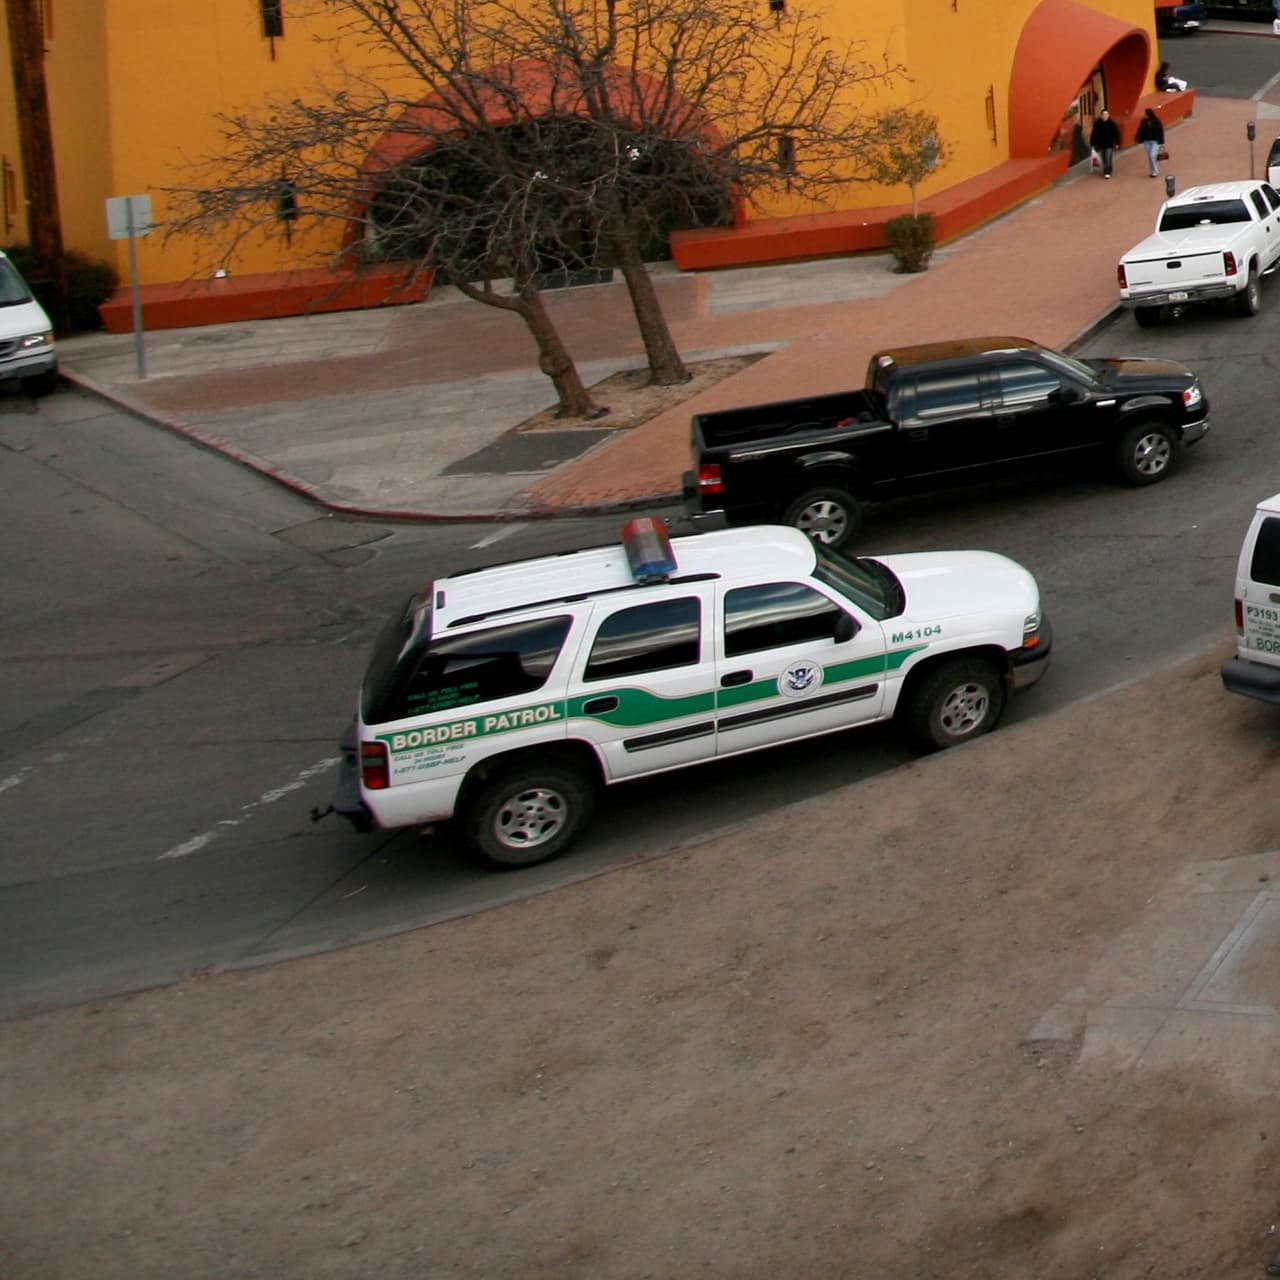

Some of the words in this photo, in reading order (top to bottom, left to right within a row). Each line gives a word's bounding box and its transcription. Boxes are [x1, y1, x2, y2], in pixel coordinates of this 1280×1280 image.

[1247, 606, 1279, 621] P3193
[892, 625, 942, 644] M4104
[392, 721, 477, 750] BORDER
[483, 705, 561, 732] PATROL
